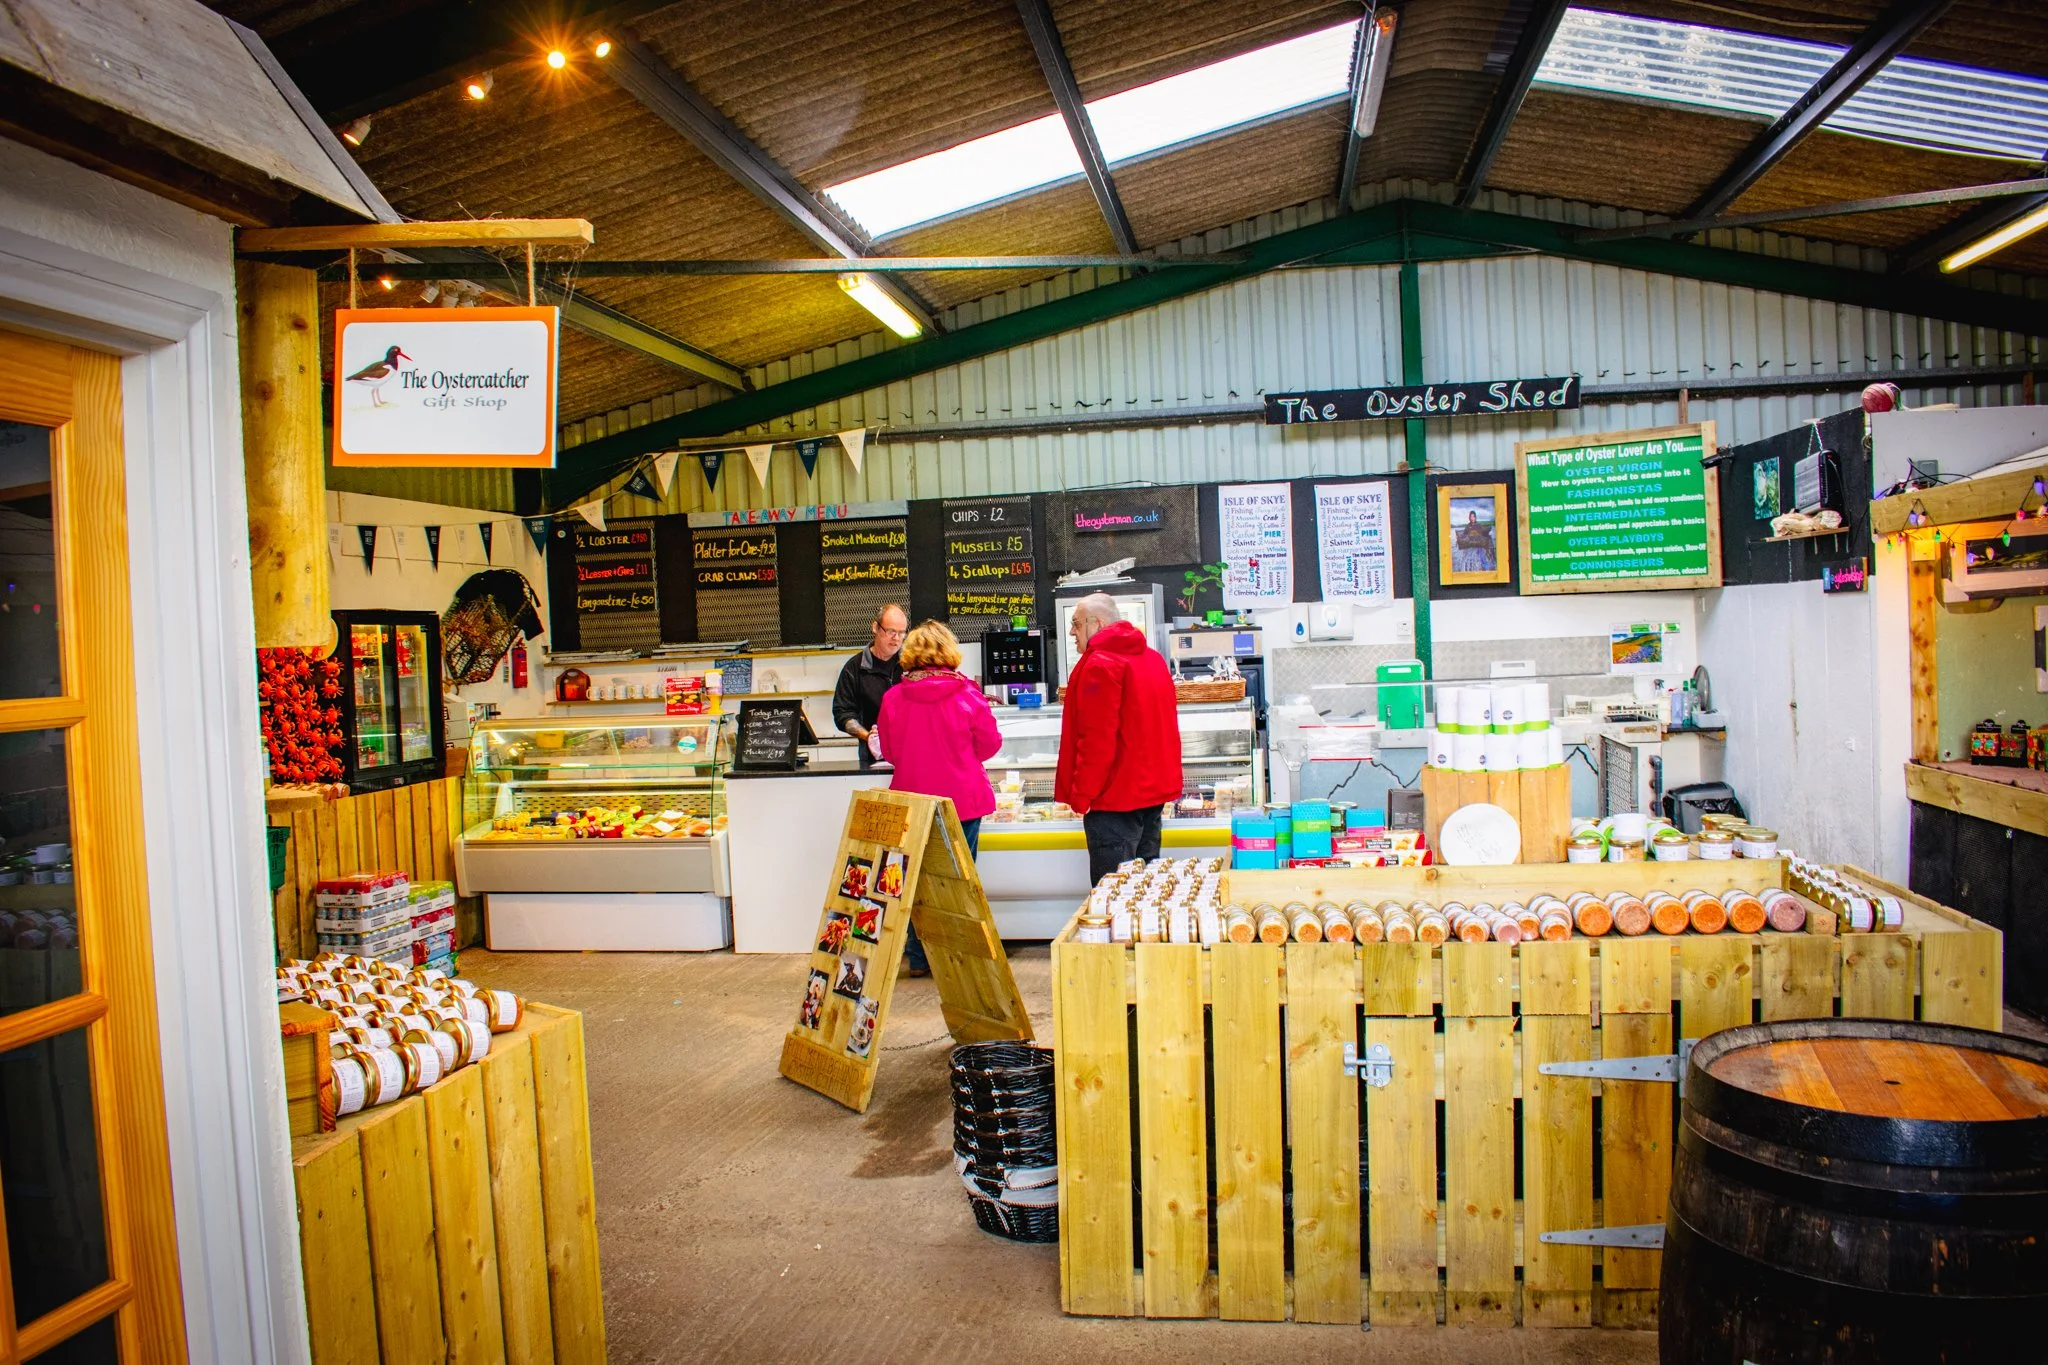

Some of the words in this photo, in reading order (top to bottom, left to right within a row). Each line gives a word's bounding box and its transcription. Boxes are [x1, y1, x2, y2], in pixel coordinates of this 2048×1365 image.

[401, 368, 427, 389] The
[432, 368, 529, 396] Oystercatcher
[423, 396, 456, 411] Gift
[464, 396, 507, 411] Shop
[1278, 397, 1337, 423] The
[1367, 387, 1466, 415] Oyster
[1479, 377, 1573, 411] Shed
[1528, 453, 1550, 466] What
[1551, 452, 1573, 467] Type
[1575, 449, 1584, 461] of
[1586, 448, 1616, 463] Oyster
[1618, 444, 1644, 458] Lover
[1646, 442, 1662, 455] Are
[1566, 465, 1614, 477] OYSTER
[1618, 461, 1662, 473] VIRGIN
[1684, 468, 1691, 476] it
[1567, 484, 1662, 499] FASHIONISTAS
[1224, 497, 1245, 506] ISLE
[1246, 496, 1259, 506] OF
[1260, 494, 1286, 505] SKYE
[1320, 497, 1341, 506] ISLE
[1342, 496, 1355, 506] OF
[1357, 494, 1382, 504] SKYE
[723, 507, 796, 526] TAKE-AWAY
[806, 504, 848, 520] MENU
[952, 510, 979, 523] CHIPS
[990, 508, 1005, 521] £2
[1075, 510, 1159, 529] theoysterman.co.uk
[1360, 513, 1375, 521] Crab
[1566, 508, 1665, 522] INTERMEDIATES
[590, 535, 631, 546] LOBSTER
[822, 534, 855, 548] Smoked
[1264, 530, 1281, 538] PIER
[1568, 536, 1607, 547] OYSTER
[1610, 533, 1664, 544] PLAYBOYS
[694, 542, 726, 559] Platter
[728, 539, 739, 558] for
[951, 541, 1003, 555] MUSSELS
[1007, 536, 1023, 552] £5
[1570, 558, 1664, 570] CONNOISSEURS
[698, 572, 724, 583] CRAB
[726, 571, 758, 582] CLAWS
[949, 566, 960, 579] 4
[962, 564, 1010, 579] Scallops
[1358, 588, 1374, 596] Crab
[960, 604, 982, 615] garlic
[862, 802, 901, 823] SAMPLE
